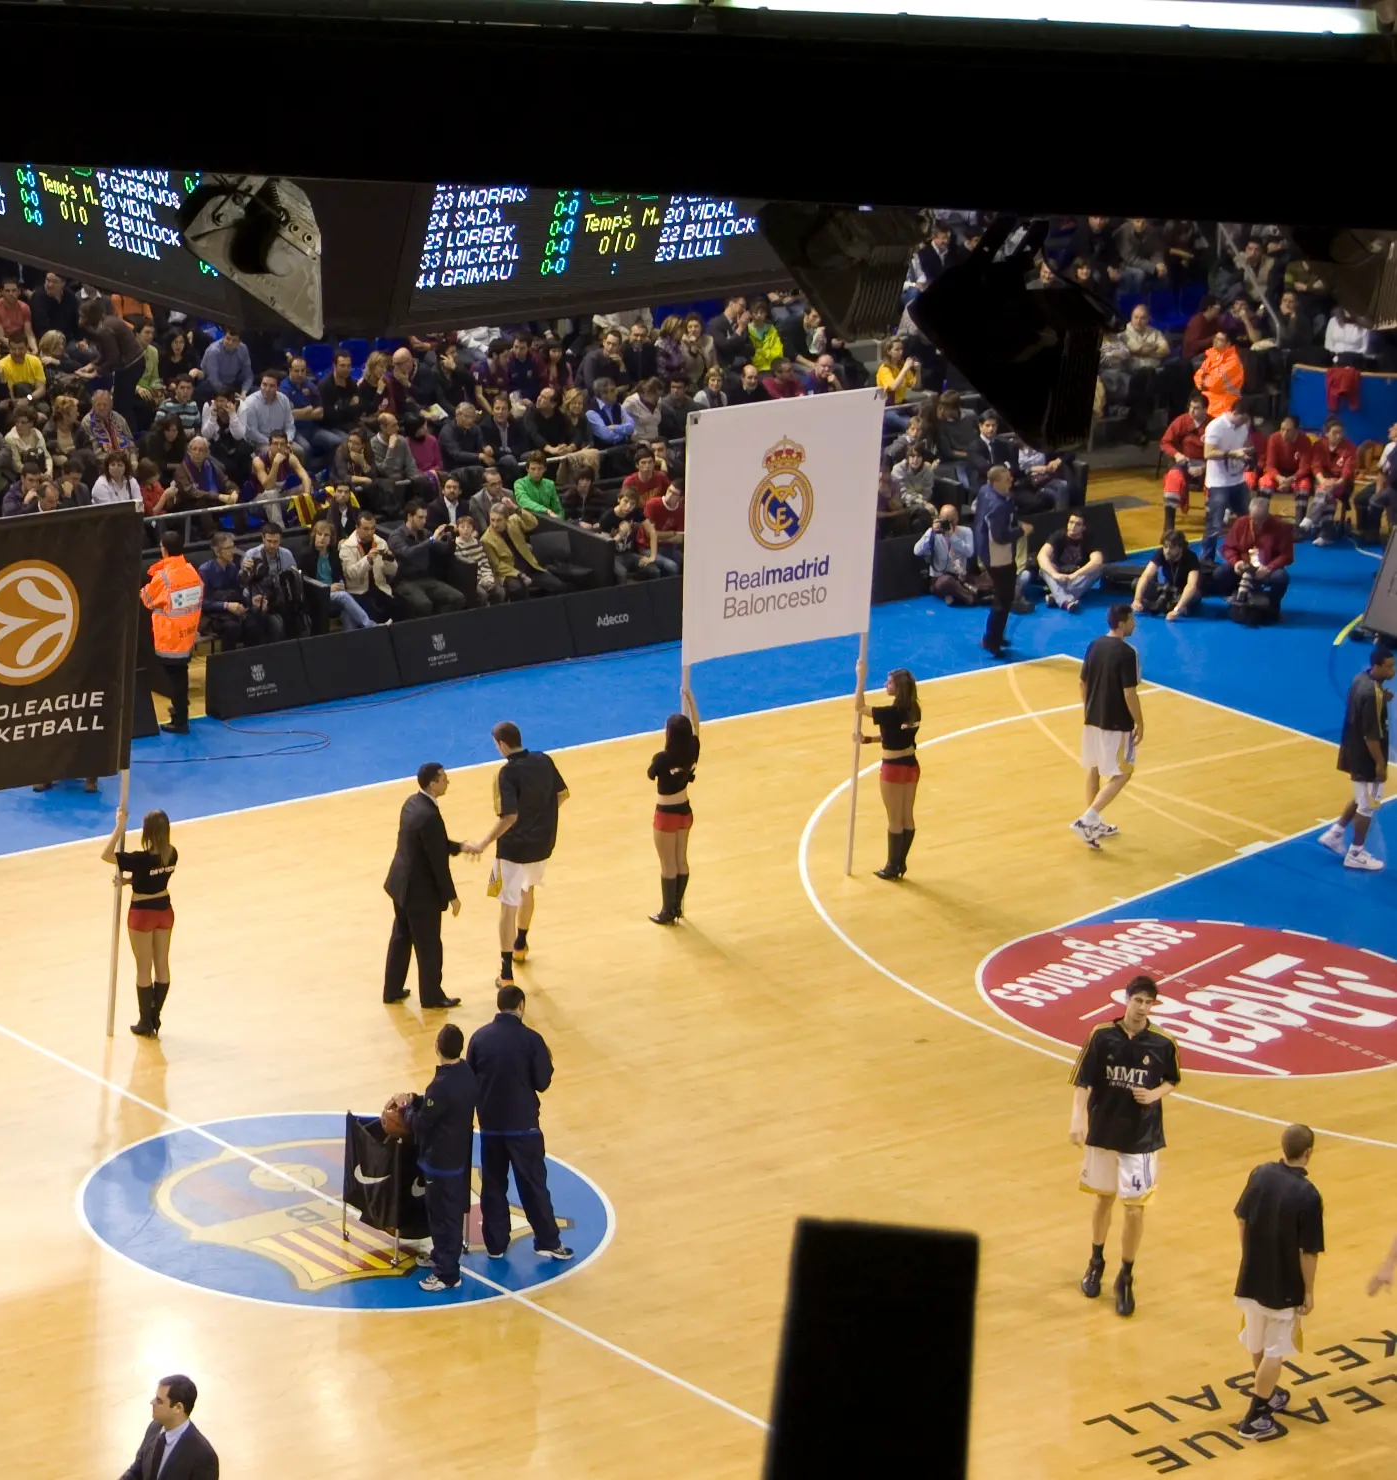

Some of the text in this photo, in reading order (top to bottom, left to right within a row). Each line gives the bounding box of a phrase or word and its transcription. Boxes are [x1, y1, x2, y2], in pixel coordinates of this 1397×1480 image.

[100, 191, 156, 222] 20 VIDAL
[432, 187, 528, 211] 23 MORRIS
[427, 208, 502, 231] 24 SADA
[663, 201, 734, 224] 20 VIDAL
[104, 211, 181, 247] 22 BULLOCK
[423, 224, 516, 251] 25 LORBEK
[658, 217, 756, 243] 22 BULLOCK
[107, 230, 160, 260] 23 LLULL
[419, 244, 519, 270] 33 MICKEAL
[654, 240, 722, 263] 23 LLULL
[415, 263, 513, 290] 44 GRIMAU
[724, 555, 830, 592] Realmadrid
[723, 585, 827, 619] Baloncesto
[597, 613, 629, 627] Adecco
[989, 921, 1197, 1008] assegurances
[1106, 1065, 1148, 1085] MMT
